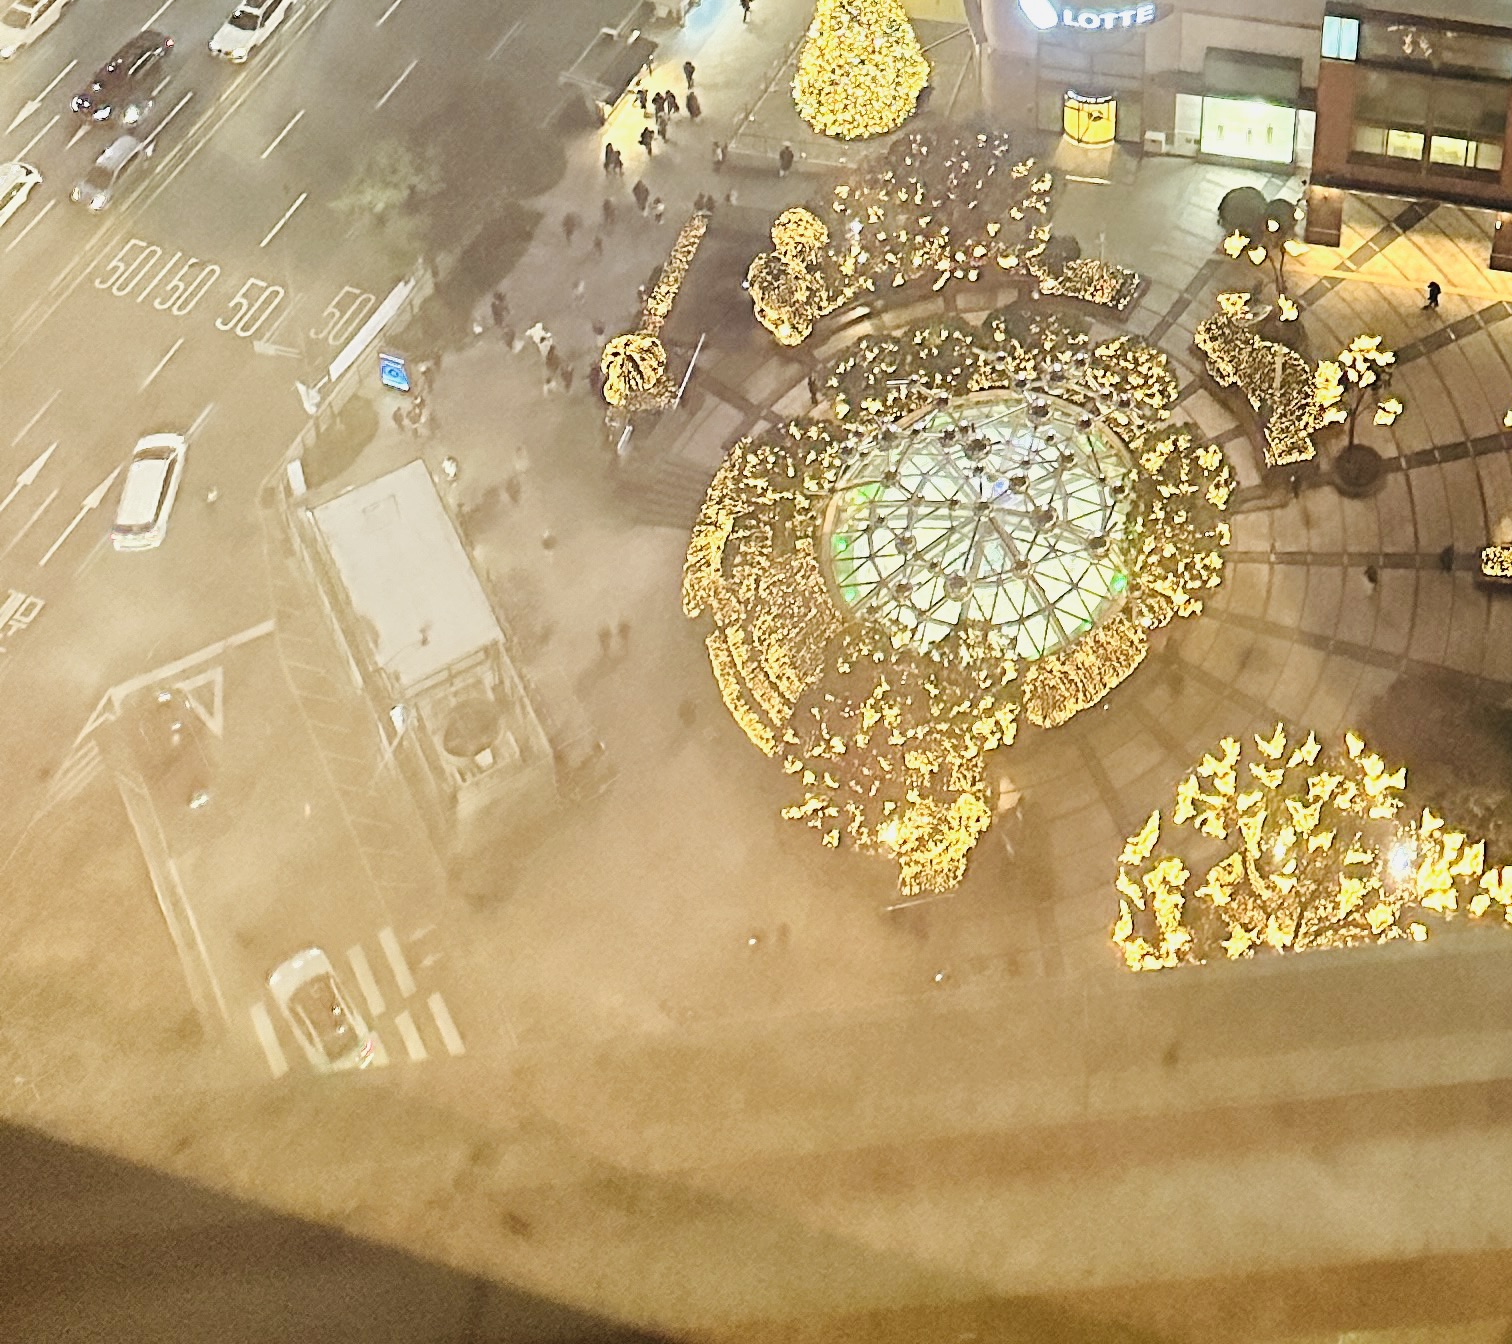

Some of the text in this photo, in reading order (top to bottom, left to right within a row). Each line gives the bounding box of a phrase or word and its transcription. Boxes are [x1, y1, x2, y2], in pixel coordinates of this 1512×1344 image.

[1063, 3, 1155, 29] LOTTE
[95, 238, 162, 296] 50
[153, 258, 221, 315] 50
[215, 277, 285, 337] 50
[310, 285, 376, 345] 50
